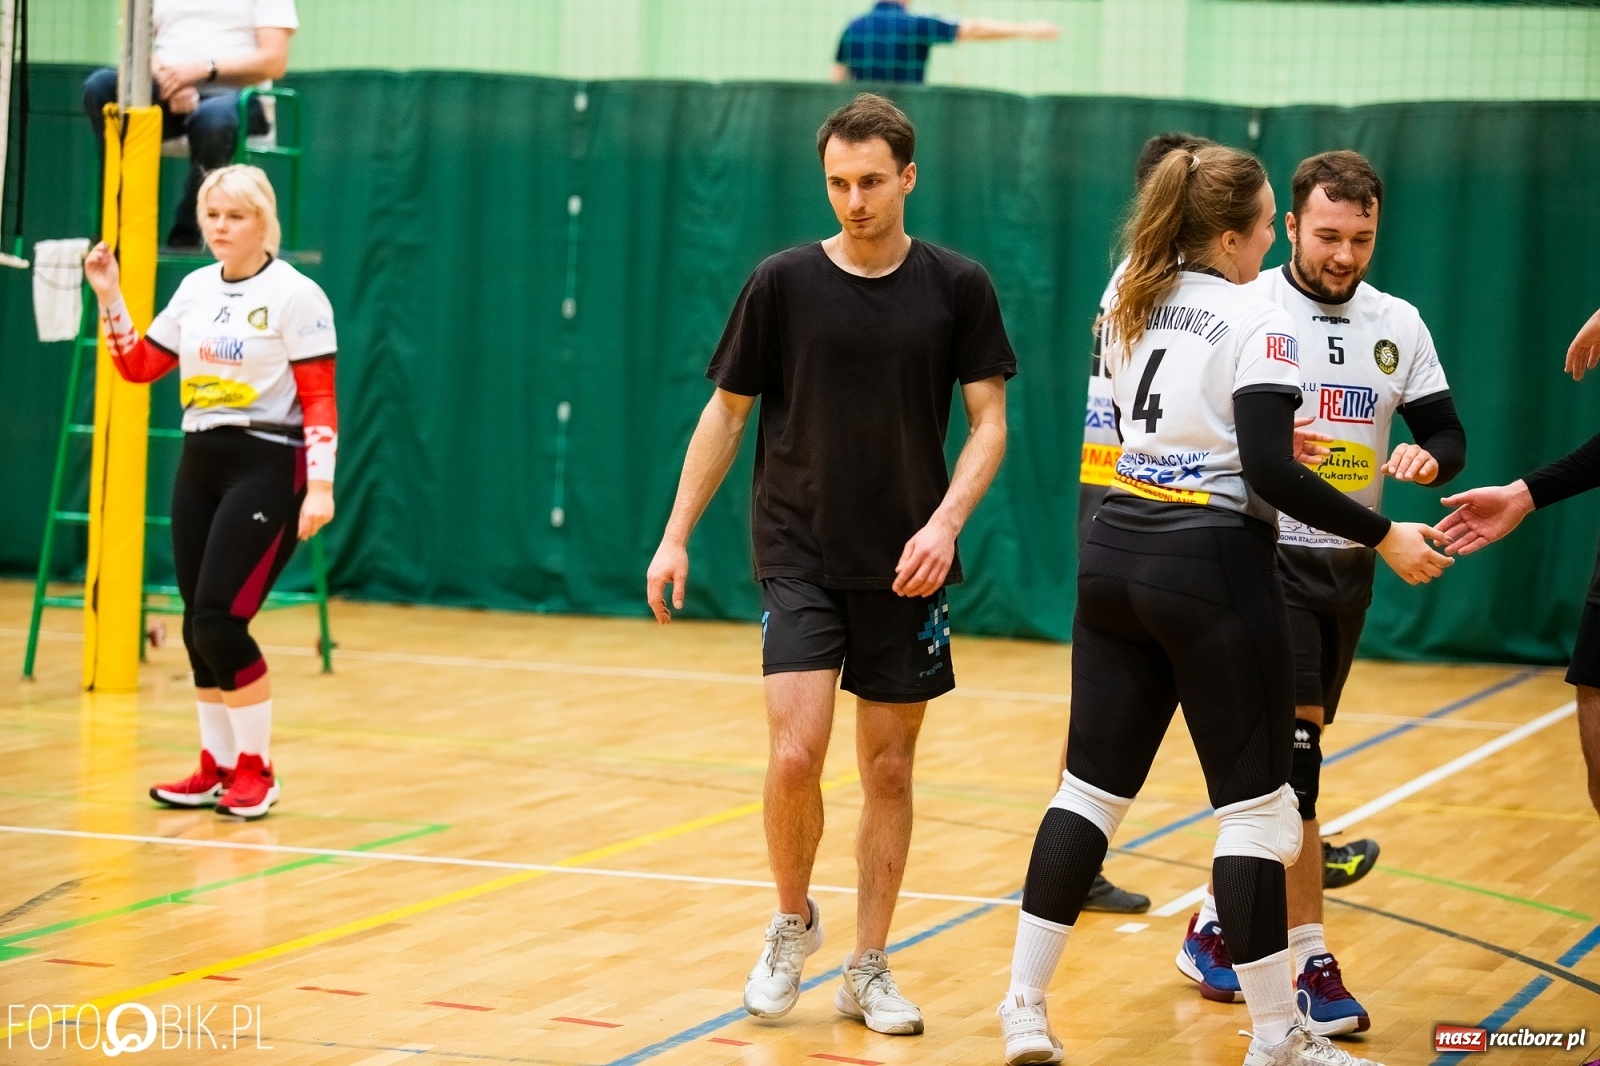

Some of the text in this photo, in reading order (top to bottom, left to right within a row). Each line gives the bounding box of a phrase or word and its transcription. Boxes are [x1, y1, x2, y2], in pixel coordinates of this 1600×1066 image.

[1312, 315, 1350, 325] regio
[1327, 336, 1345, 366] 5
[1131, 348, 1168, 434] 4
[1319, 383, 1379, 424] REMIX
